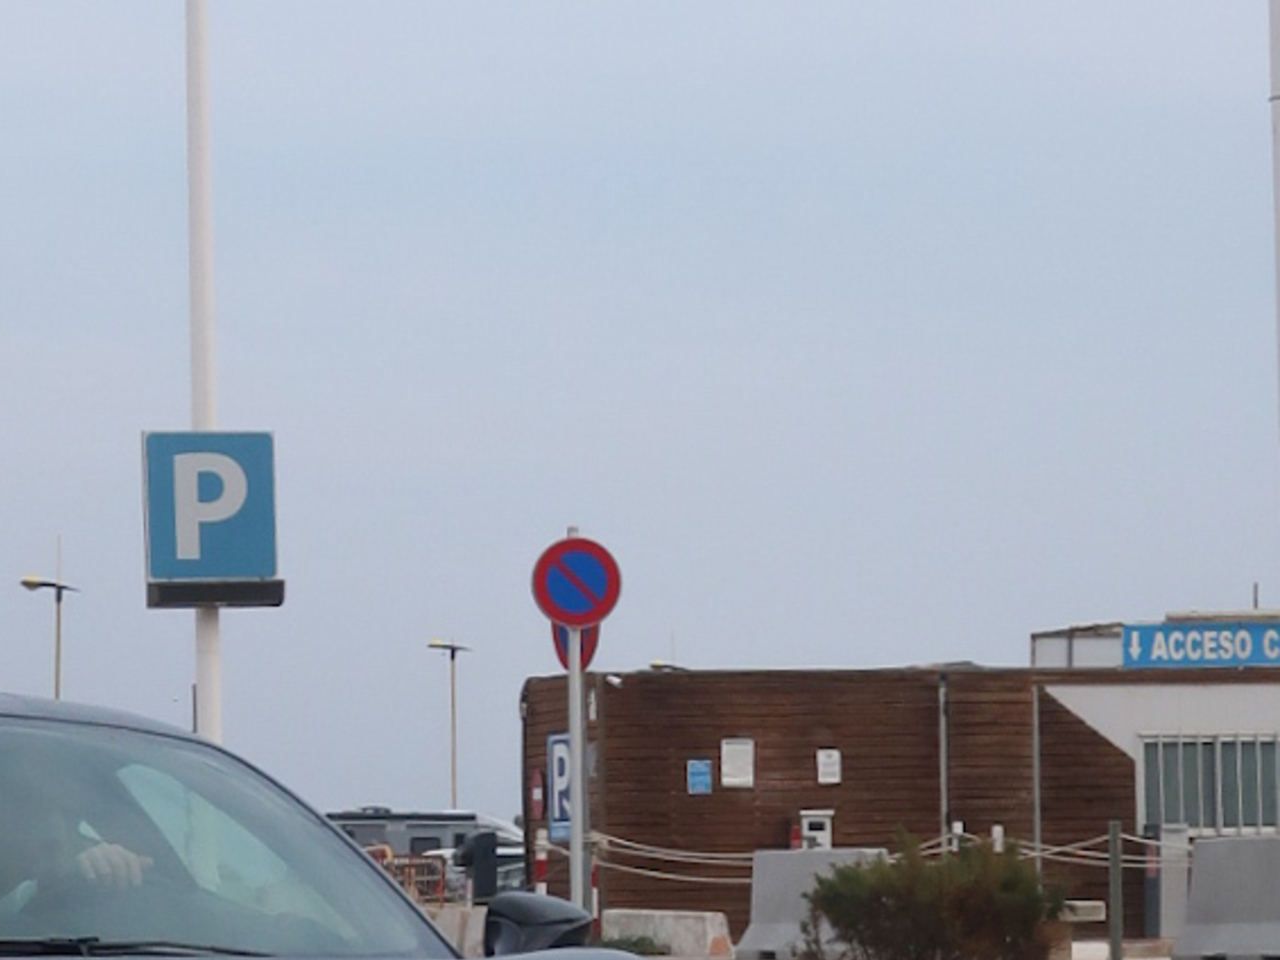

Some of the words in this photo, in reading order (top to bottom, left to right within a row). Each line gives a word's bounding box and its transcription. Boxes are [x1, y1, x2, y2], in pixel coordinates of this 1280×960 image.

[173, 451, 248, 560] P
[1150, 629, 1252, 661] ACCESO
[1263, 628, 1280, 660] C
